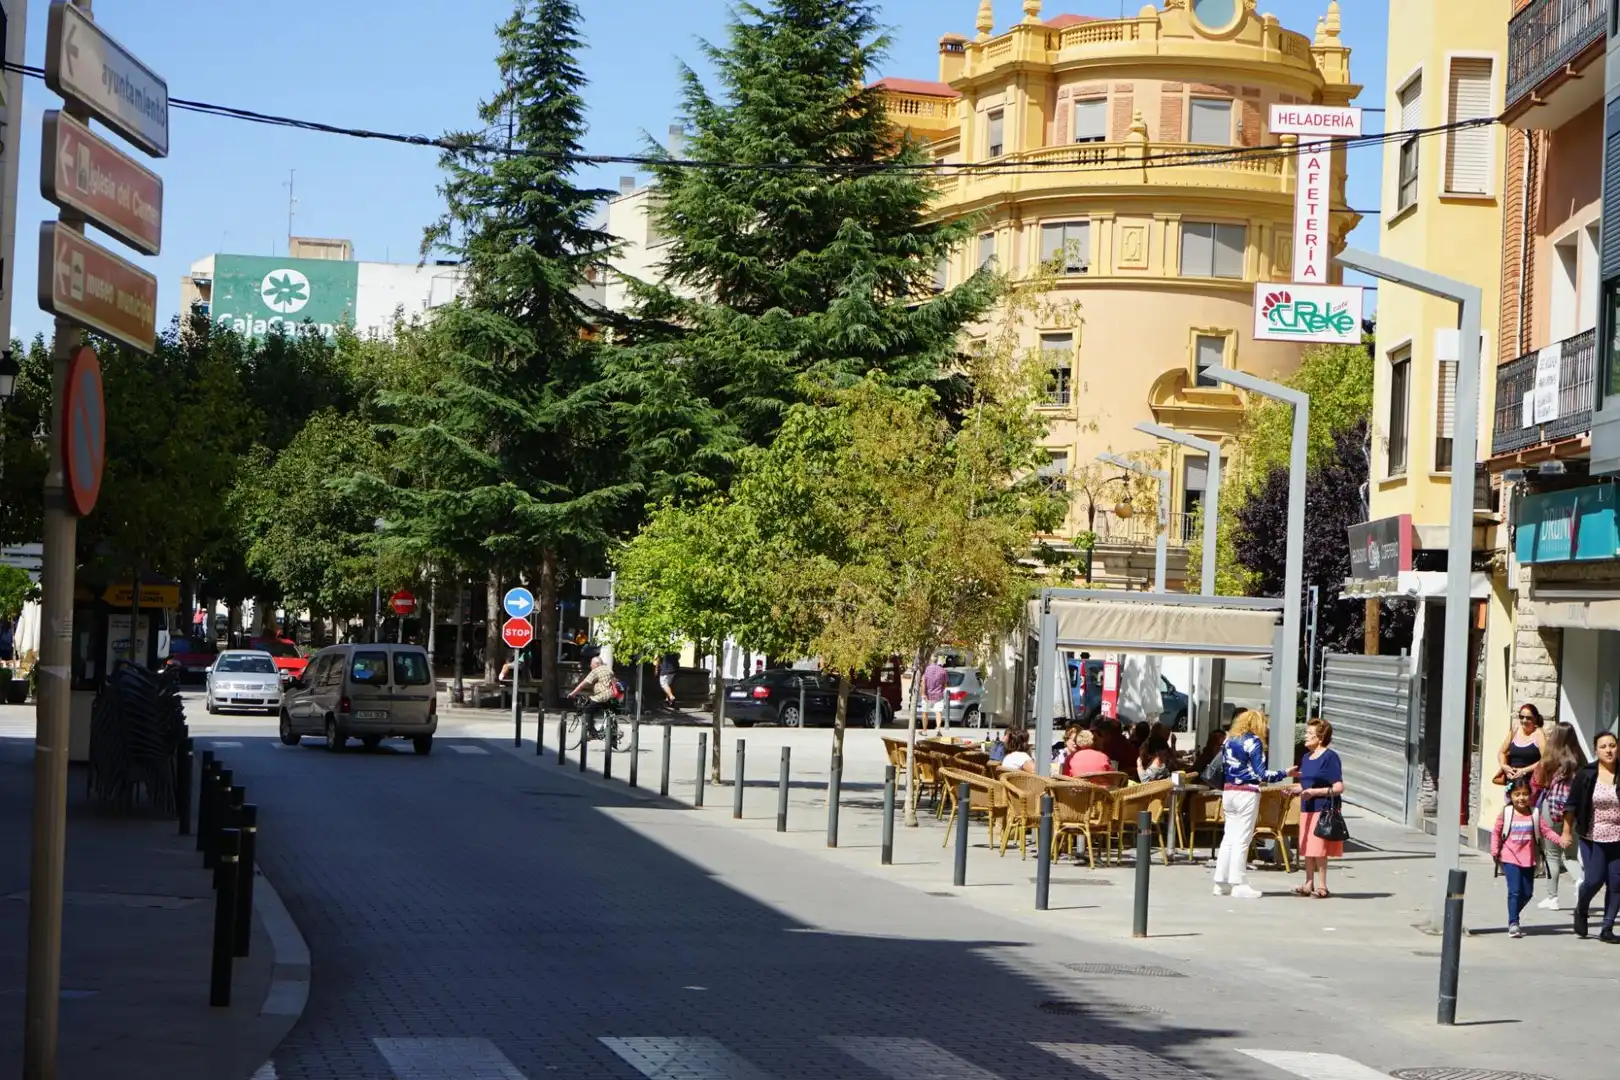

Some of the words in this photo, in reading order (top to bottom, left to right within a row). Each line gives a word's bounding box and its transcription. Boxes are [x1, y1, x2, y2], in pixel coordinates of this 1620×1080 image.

[102, 66, 165, 128] ayuntamiento
[1278, 111, 1354, 128] HELADERÍA
[217, 312, 342, 341] CajaCap
[505, 628, 530, 637] STOP
